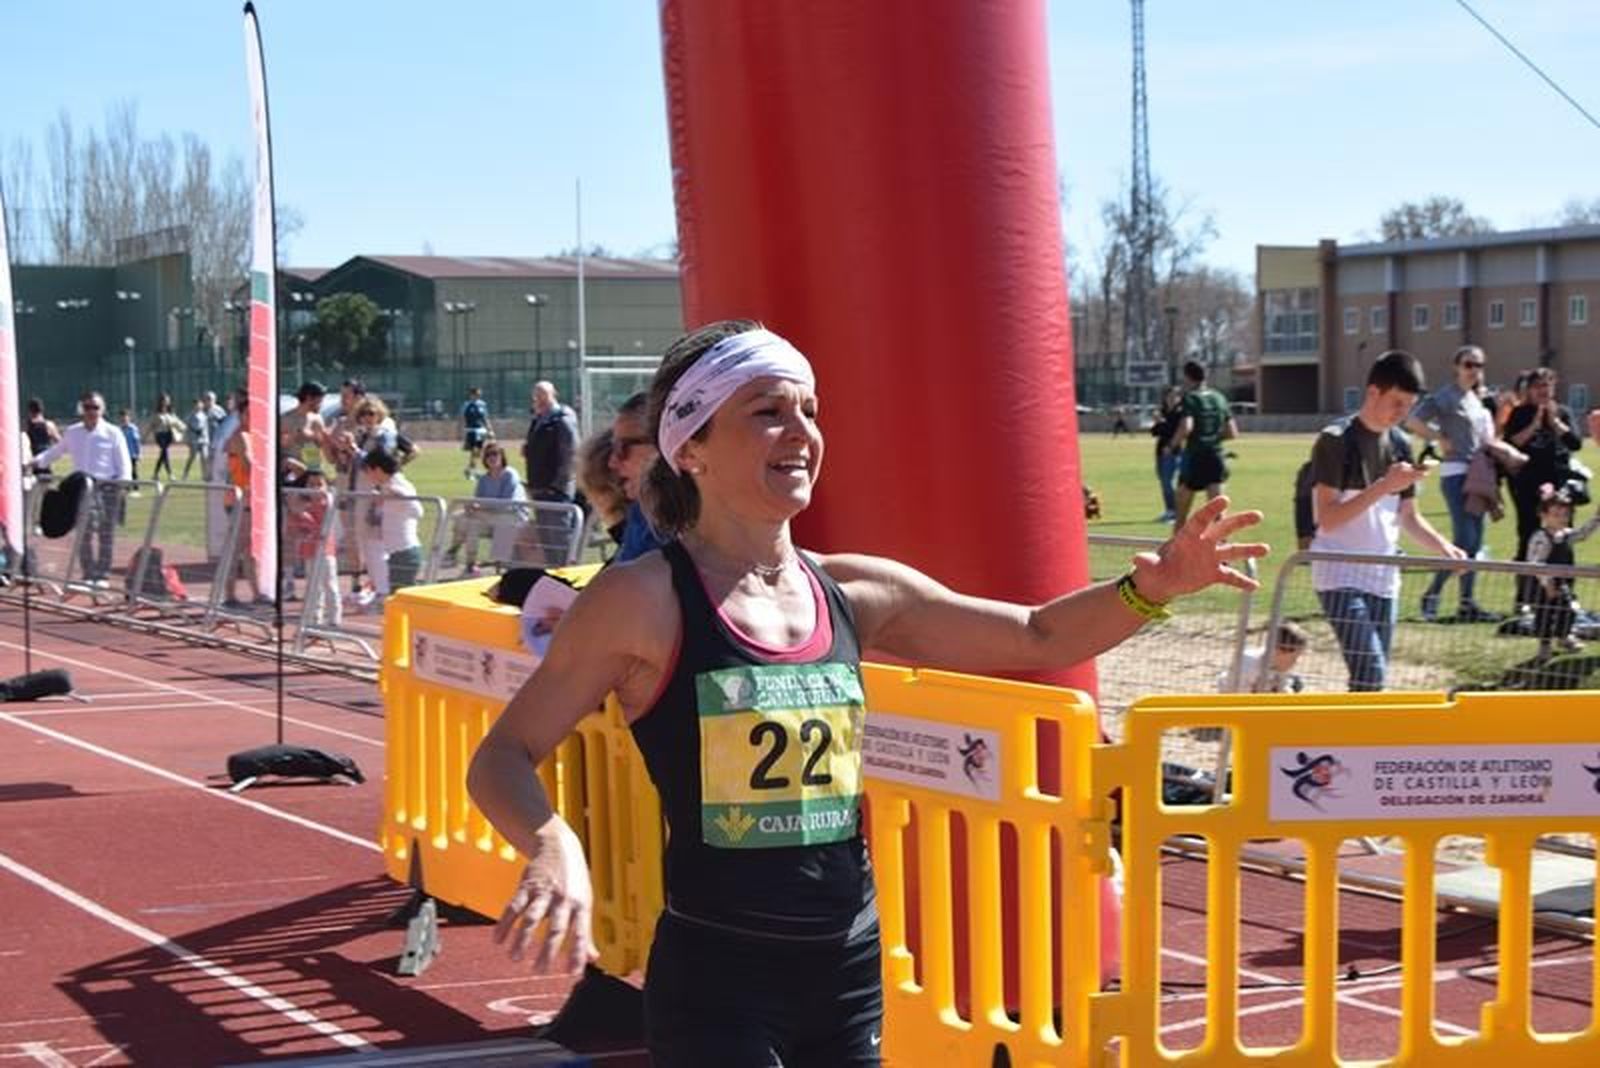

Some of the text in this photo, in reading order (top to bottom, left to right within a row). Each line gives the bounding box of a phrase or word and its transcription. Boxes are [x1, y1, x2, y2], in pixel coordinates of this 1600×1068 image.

[750, 719, 833, 790] 22
[1375, 759, 1553, 774] FEDERACIÓN DE ATLETISMO
[1374, 777, 1394, 790] DE
[1404, 776, 1480, 790] CASTILLA
[1492, 776, 1501, 788] Y
[1380, 793, 1546, 806] DELEGACIÓN DE ZAMORA
[758, 808, 853, 833] CAJA RURA
